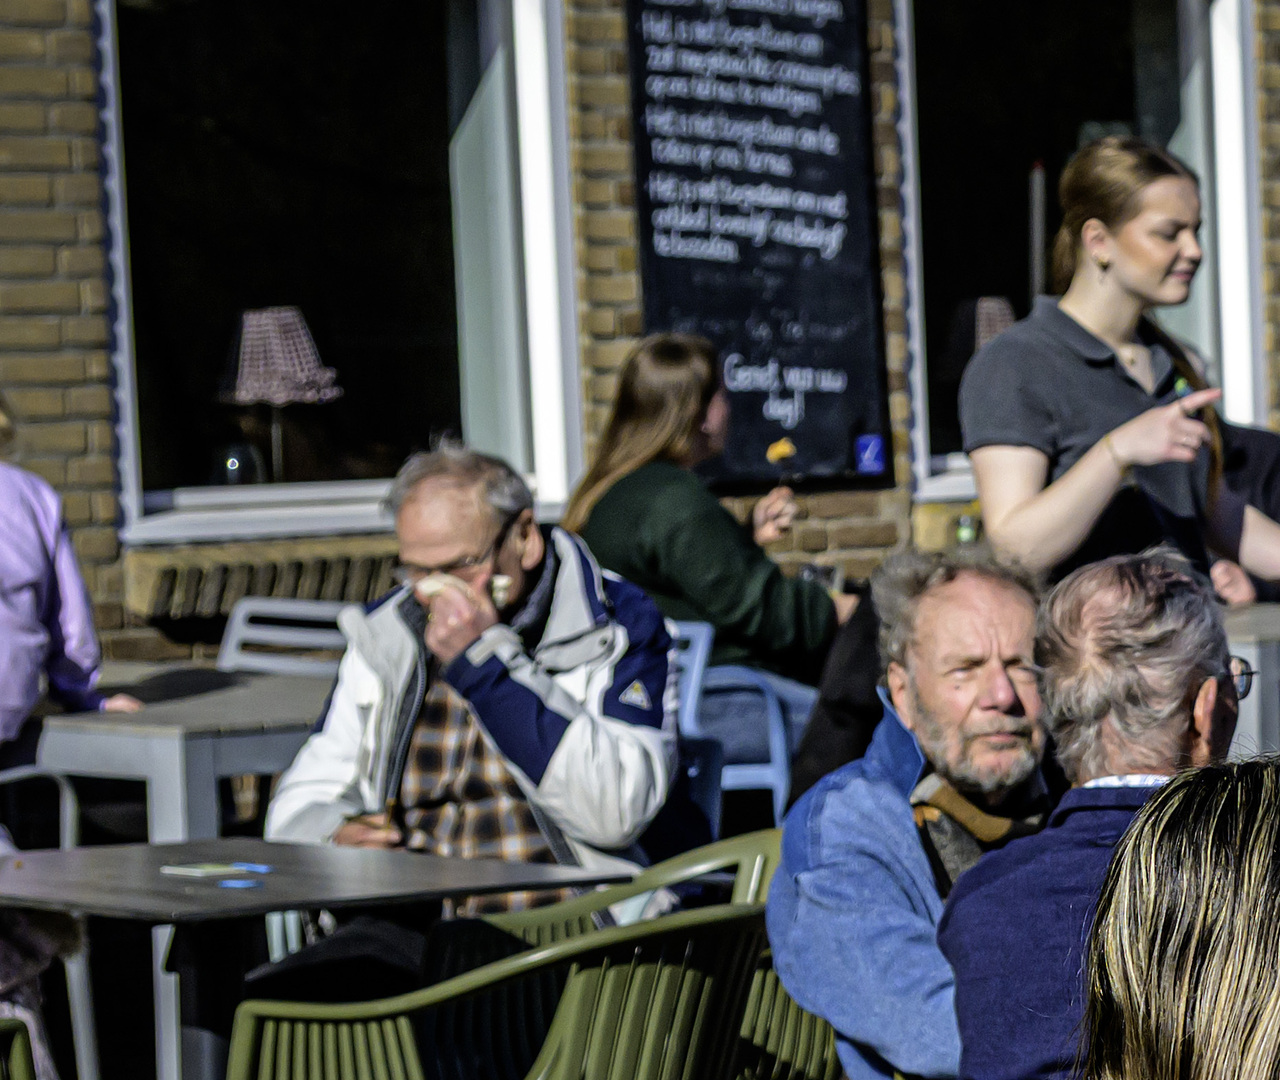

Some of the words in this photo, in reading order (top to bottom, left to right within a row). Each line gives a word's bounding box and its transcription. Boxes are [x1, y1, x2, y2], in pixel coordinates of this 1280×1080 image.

[643, 12, 673, 42] Het
[720, 18, 796, 54] toegestaan
[797, 34, 822, 57] om
[646, 75, 665, 100] op
[666, 77, 691, 97] ons
[692, 77, 738, 102] terras
[757, 86, 822, 116] nuttigen
[646, 105, 677, 134] Het
[720, 113, 796, 148] toegestaan
[651, 138, 695, 164] roken
[695, 144, 714, 171] op
[715, 146, 742, 169] ons
[744, 145, 793, 176] terras
[649, 172, 678, 202] Het
[721, 177, 793, 210] toegestaan
[819, 189, 849, 219] met
[724, 353, 781, 393] Geniet
[782, 366, 814, 391] van
[815, 368, 848, 393] uw
